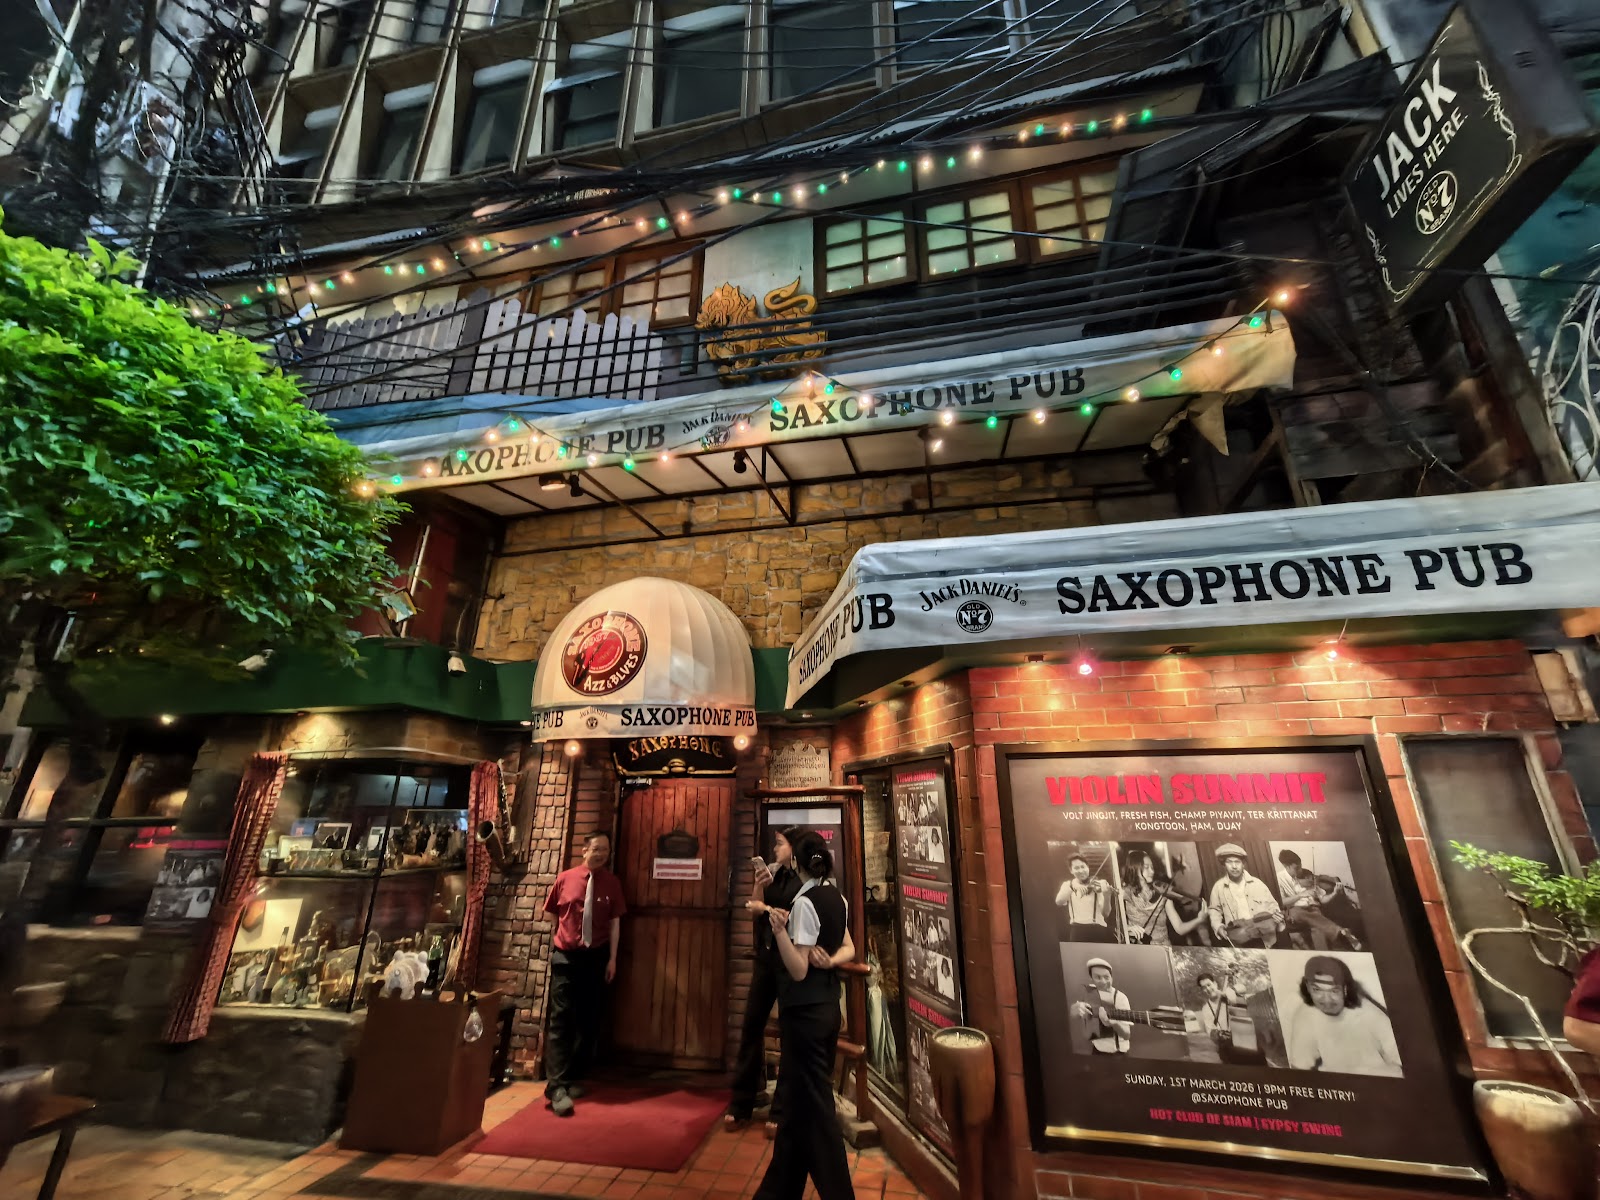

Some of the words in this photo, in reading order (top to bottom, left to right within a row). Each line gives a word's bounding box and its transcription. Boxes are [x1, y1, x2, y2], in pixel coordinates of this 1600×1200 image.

[1373, 58, 1457, 199] JACK
[1387, 163, 1424, 218] LIVES
[1423, 180, 1438, 200] OLD
[1009, 367, 1085, 400] PUB
[606, 424, 665, 454] PUB
[1056, 553, 1391, 614] SAXOPHONE
[1404, 542, 1533, 591] PUB
[919, 584, 959, 612] JACK
[841, 593, 895, 639] PUB
[542, 710, 564, 729] PUB
[620, 707, 732, 727] SAXOPHONE
[734, 709, 755, 727] PUB
[1045, 775, 1164, 805] VIOLIN
[1169, 772, 1327, 805] SUMMIT
[1063, 811, 1084, 820] VOLT
[1086, 811, 1118, 820] JINGJIT,
[1120, 811, 1148, 820] FRESH
[1150, 811, 1172, 820] FISH,
[1174, 811, 1207, 820] CHAMP
[1209, 810, 1245, 820] PIYAVIT,
[1247, 810, 1265, 819] TER
[1267, 810, 1318, 819] KRITTANAT
[1135, 822, 1188, 831] KONGTOON,
[1217, 822, 1242, 831] DUAY
[1125, 1073, 1167, 1087] SUNDAY,
[1169, 1076, 1187, 1088] 1ST
[1189, 1079, 1227, 1091] MARCH
[1229, 1080, 1255, 1093] 2026
[1263, 1083, 1287, 1096] 9PM
[1288, 1085, 1315, 1099] FREE
[1317, 1088, 1356, 1102] ENTRY!
[1191, 1092, 1264, 1108] @SAXOPHONE
[1266, 1098, 1289, 1110] PUB
[1149, 1108, 1173, 1120] HOT
[1175, 1110, 1204, 1124] CLUB
[1206, 1112, 1221, 1125] DE
[1222, 1115, 1253, 1129] SIAM
[1260, 1117, 1300, 1133] GYPSY
[1300, 1121, 1343, 1137] SWING
